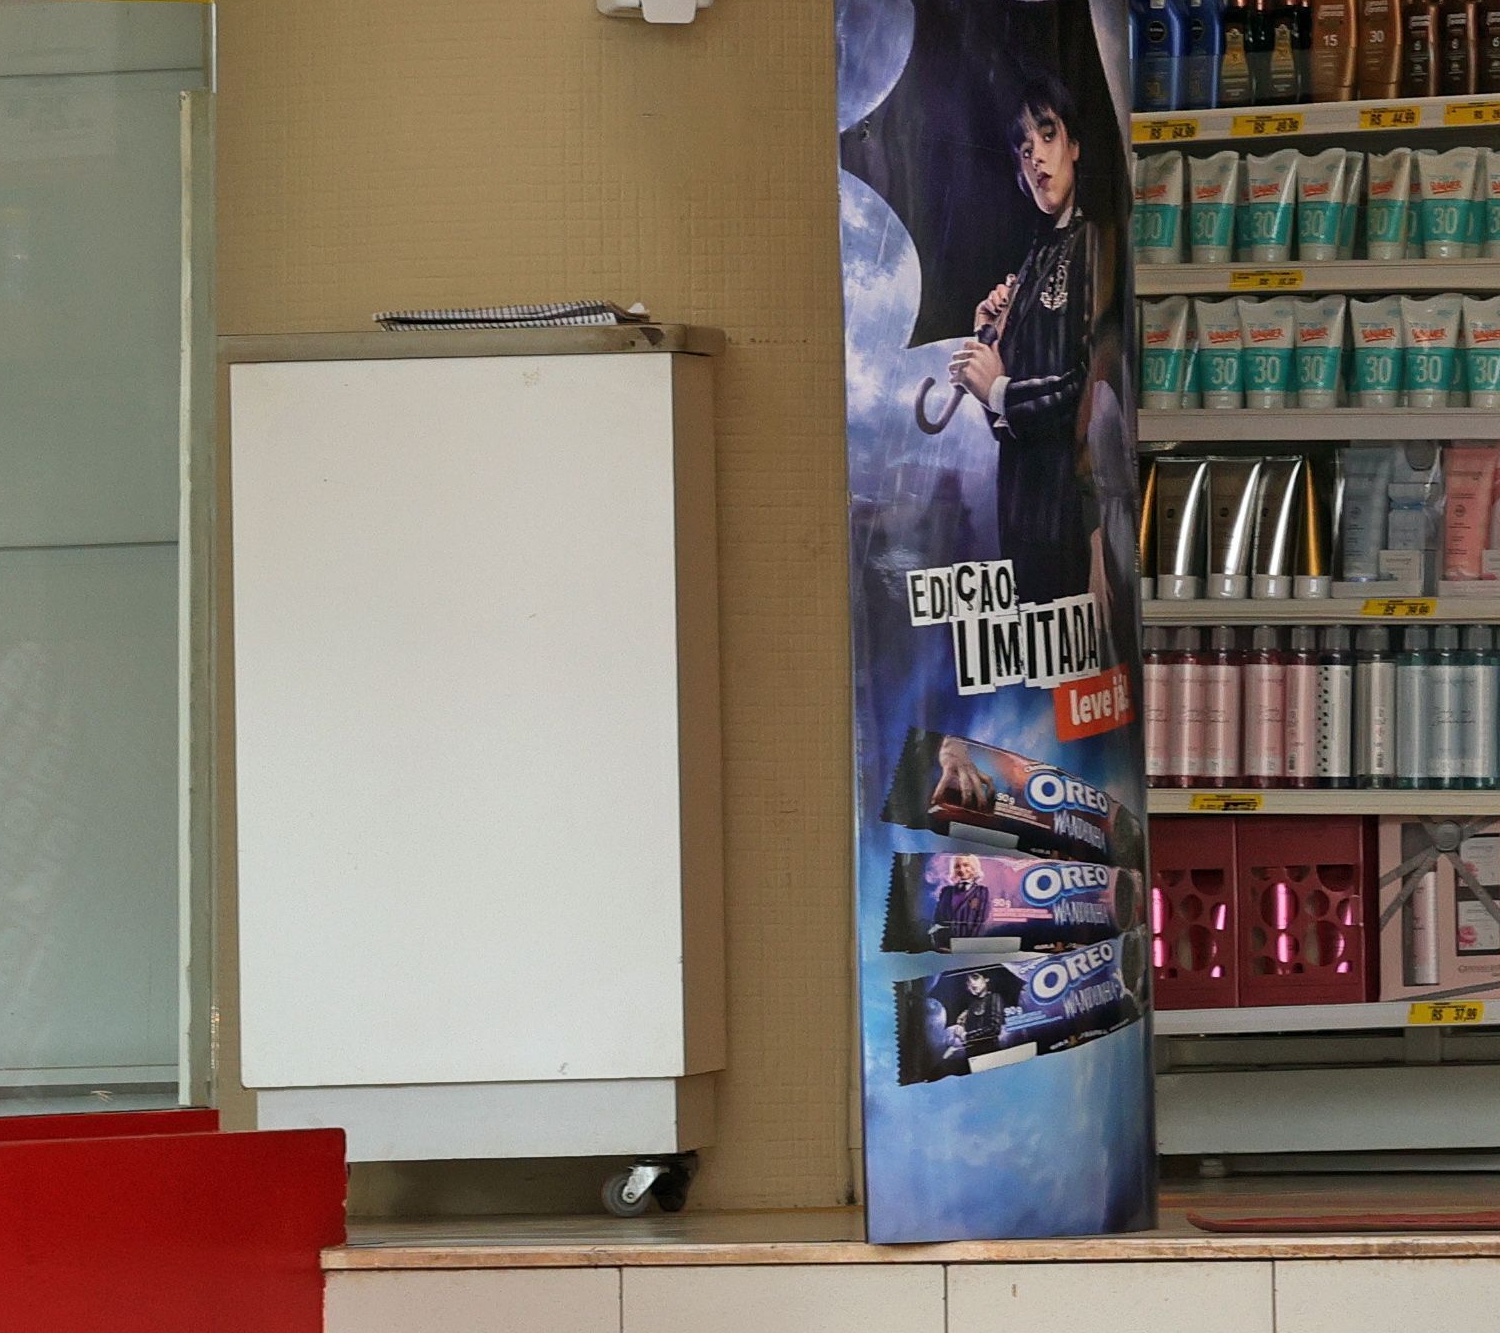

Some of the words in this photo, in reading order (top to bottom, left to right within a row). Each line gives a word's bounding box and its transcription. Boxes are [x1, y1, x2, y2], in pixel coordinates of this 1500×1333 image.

[1322, 34, 1338, 47] 15
[1369, 30, 1384, 43] 30
[1432, 207, 1458, 234] 30
[1212, 357, 1238, 384] 30
[1254, 355, 1281, 383] 30
[1365, 356, 1392, 383] 30
[1416, 355, 1443, 383] 30
[1475, 356, 1500, 383] 30
[910, 563, 1013, 621] EDIÇÃO
[956, 601, 1099, 688] LIMITADA
[1070, 686, 1112, 726] leve
[1029, 774, 1108, 814] OREO
[1024, 866, 1109, 901] OREO
[1032, 943, 1113, 999] OREO
